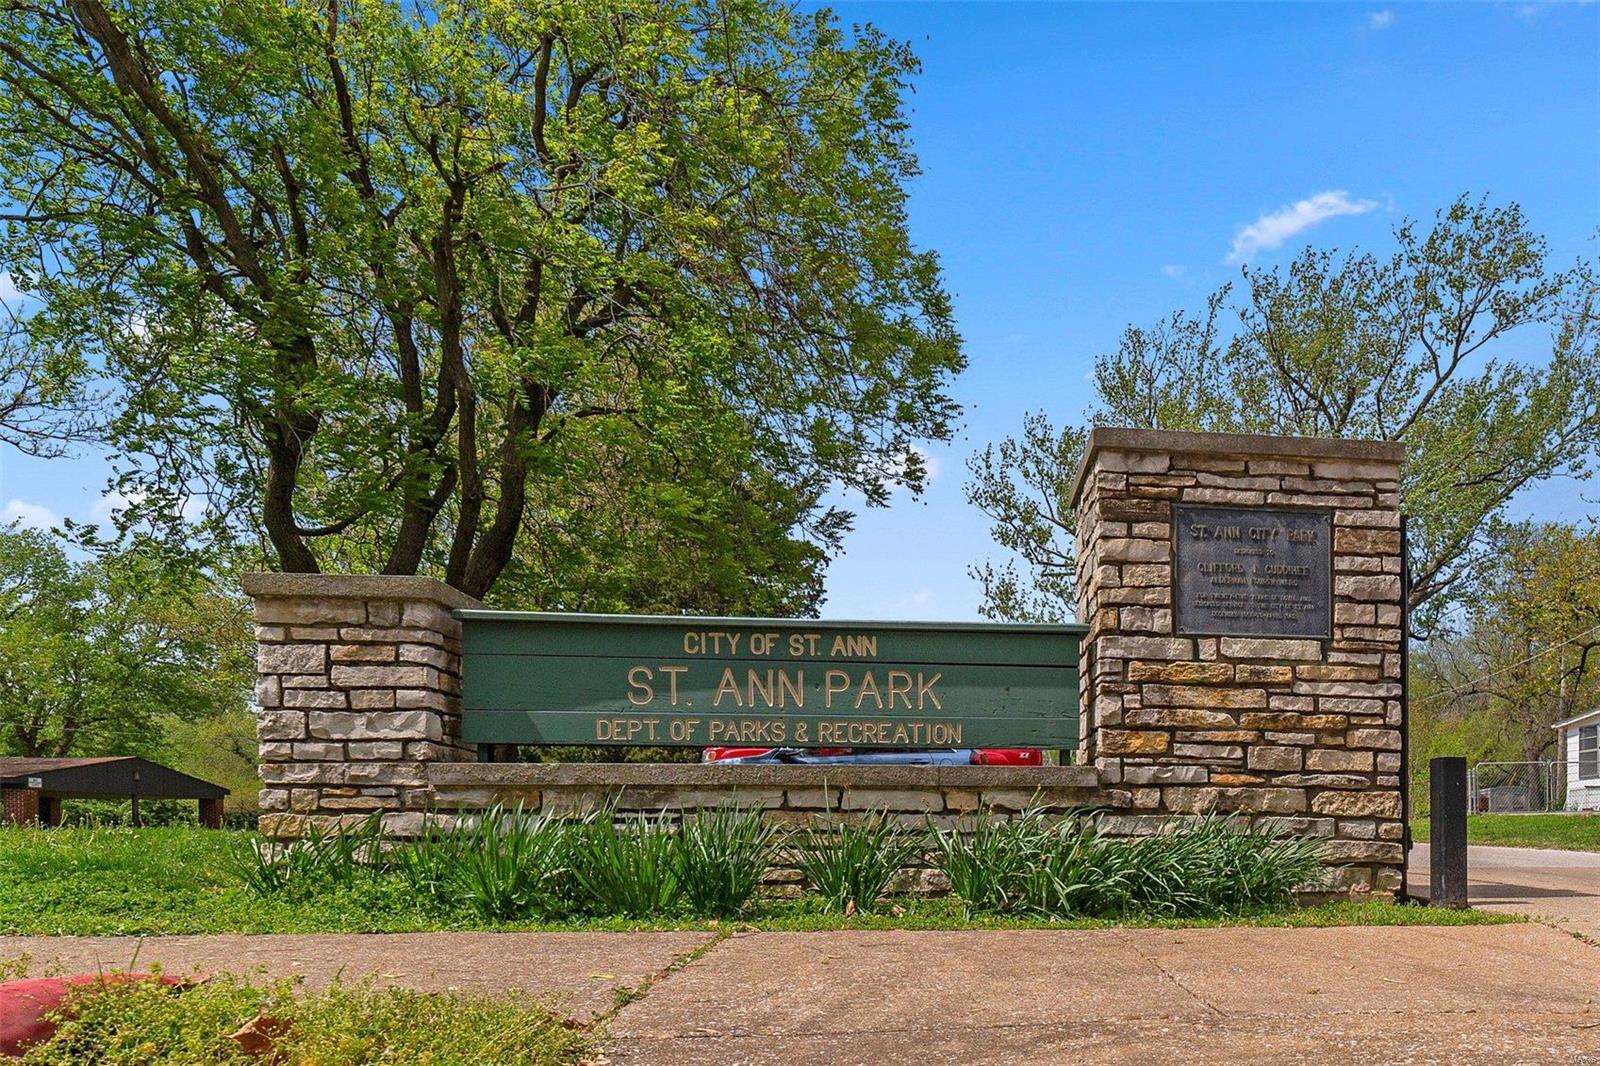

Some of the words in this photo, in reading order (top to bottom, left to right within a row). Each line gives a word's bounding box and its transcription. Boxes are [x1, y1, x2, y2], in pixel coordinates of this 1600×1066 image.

[1214, 526, 1241, 540] ANN
[1248, 527, 1280, 541] CITY
[1286, 529, 1317, 543] PARK
[683, 632, 741, 655] CITY
[750, 633, 780, 655] OF
[789, 634, 821, 656] ST.
[830, 635, 877, 657] ANN
[627, 666, 692, 706] ST.
[713, 667, 804, 709] ANN
[825, 670, 942, 711] PARK
[596, 719, 661, 742] DEPT.
[670, 720, 700, 742] OF
[709, 719, 786, 743] PARKS
[795, 722, 809, 743] &
[819, 722, 962, 745] RECREATION
